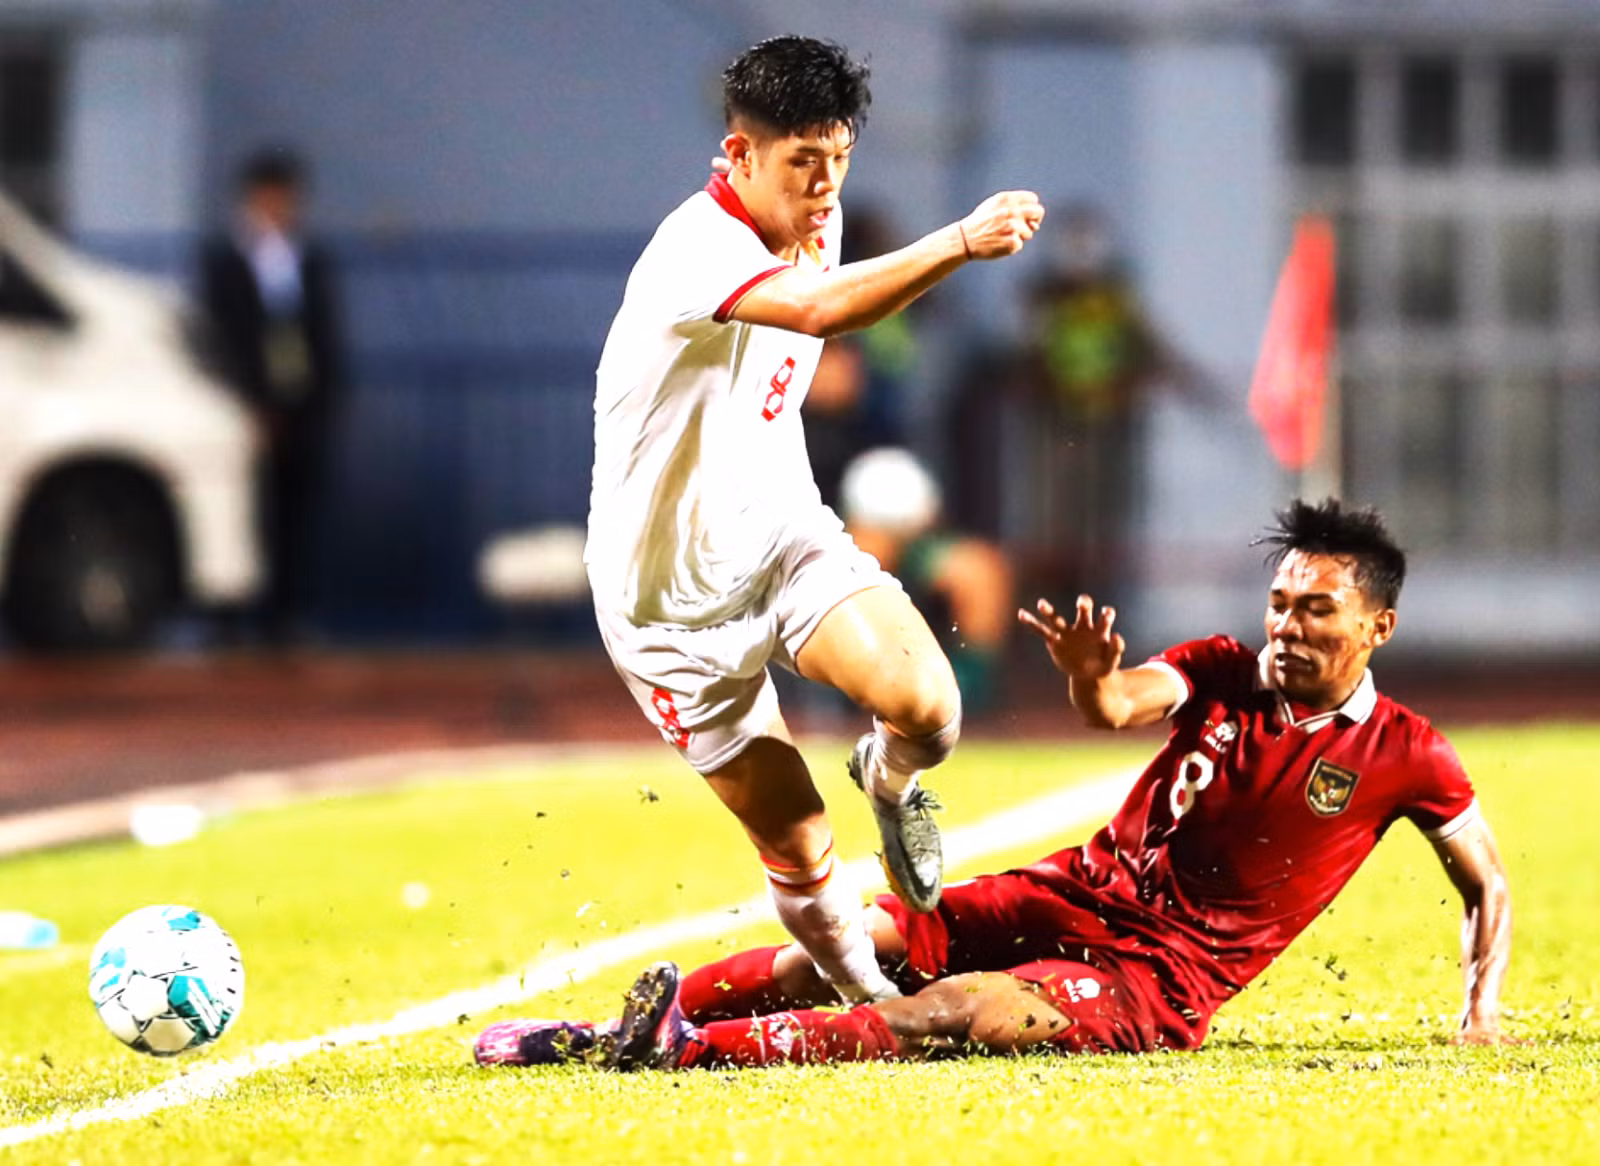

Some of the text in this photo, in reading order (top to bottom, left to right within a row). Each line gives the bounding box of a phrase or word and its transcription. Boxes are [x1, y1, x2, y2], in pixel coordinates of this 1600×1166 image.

[761, 356, 796, 422] 8
[651, 687, 690, 750] 8
[1169, 751, 1214, 820] 8
